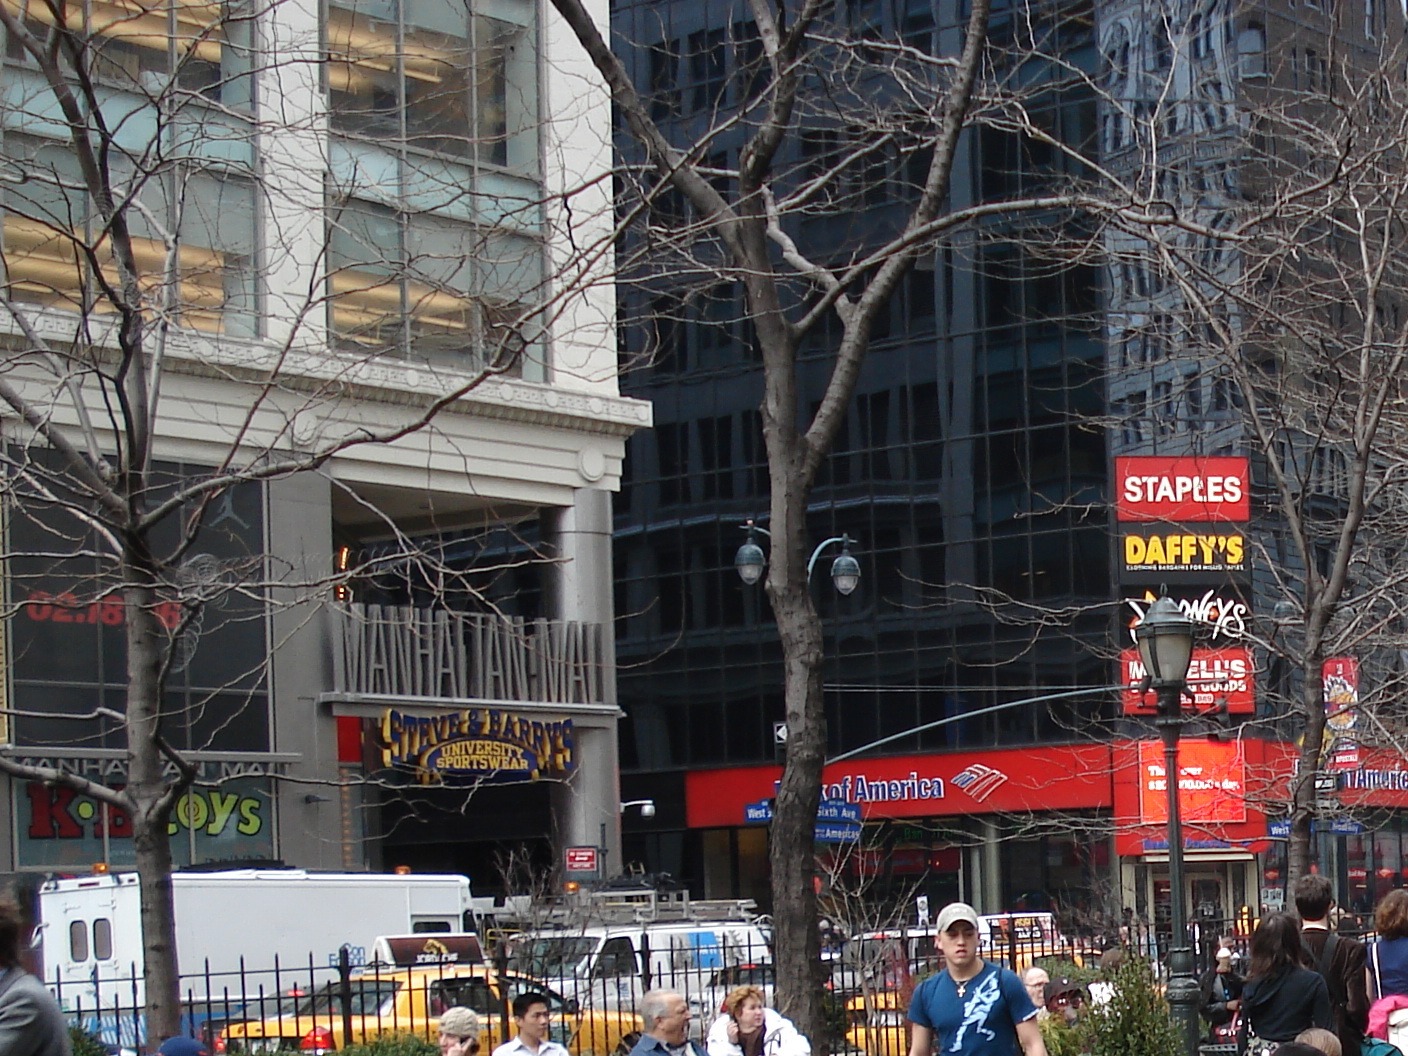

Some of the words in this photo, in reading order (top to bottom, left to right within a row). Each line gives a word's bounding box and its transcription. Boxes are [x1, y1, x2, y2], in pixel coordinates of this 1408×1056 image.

[1124, 476, 1242, 503] STAPLES
[1125, 535, 1244, 565] DAFFY'S
[1129, 659, 1246, 680] MELL'S
[383, 708, 460, 767] STEVE
[483, 708, 575, 771] BARRY'S
[441, 740, 524, 758] UNIVERSITY
[436, 756, 528, 770] SPORTSWEAR
[828, 776, 851, 800] of
[854, 772, 944, 801] America
[168, 791, 262, 836] oys
[817, 806, 838, 817] Sixth
[841, 808, 856, 819] Ave
